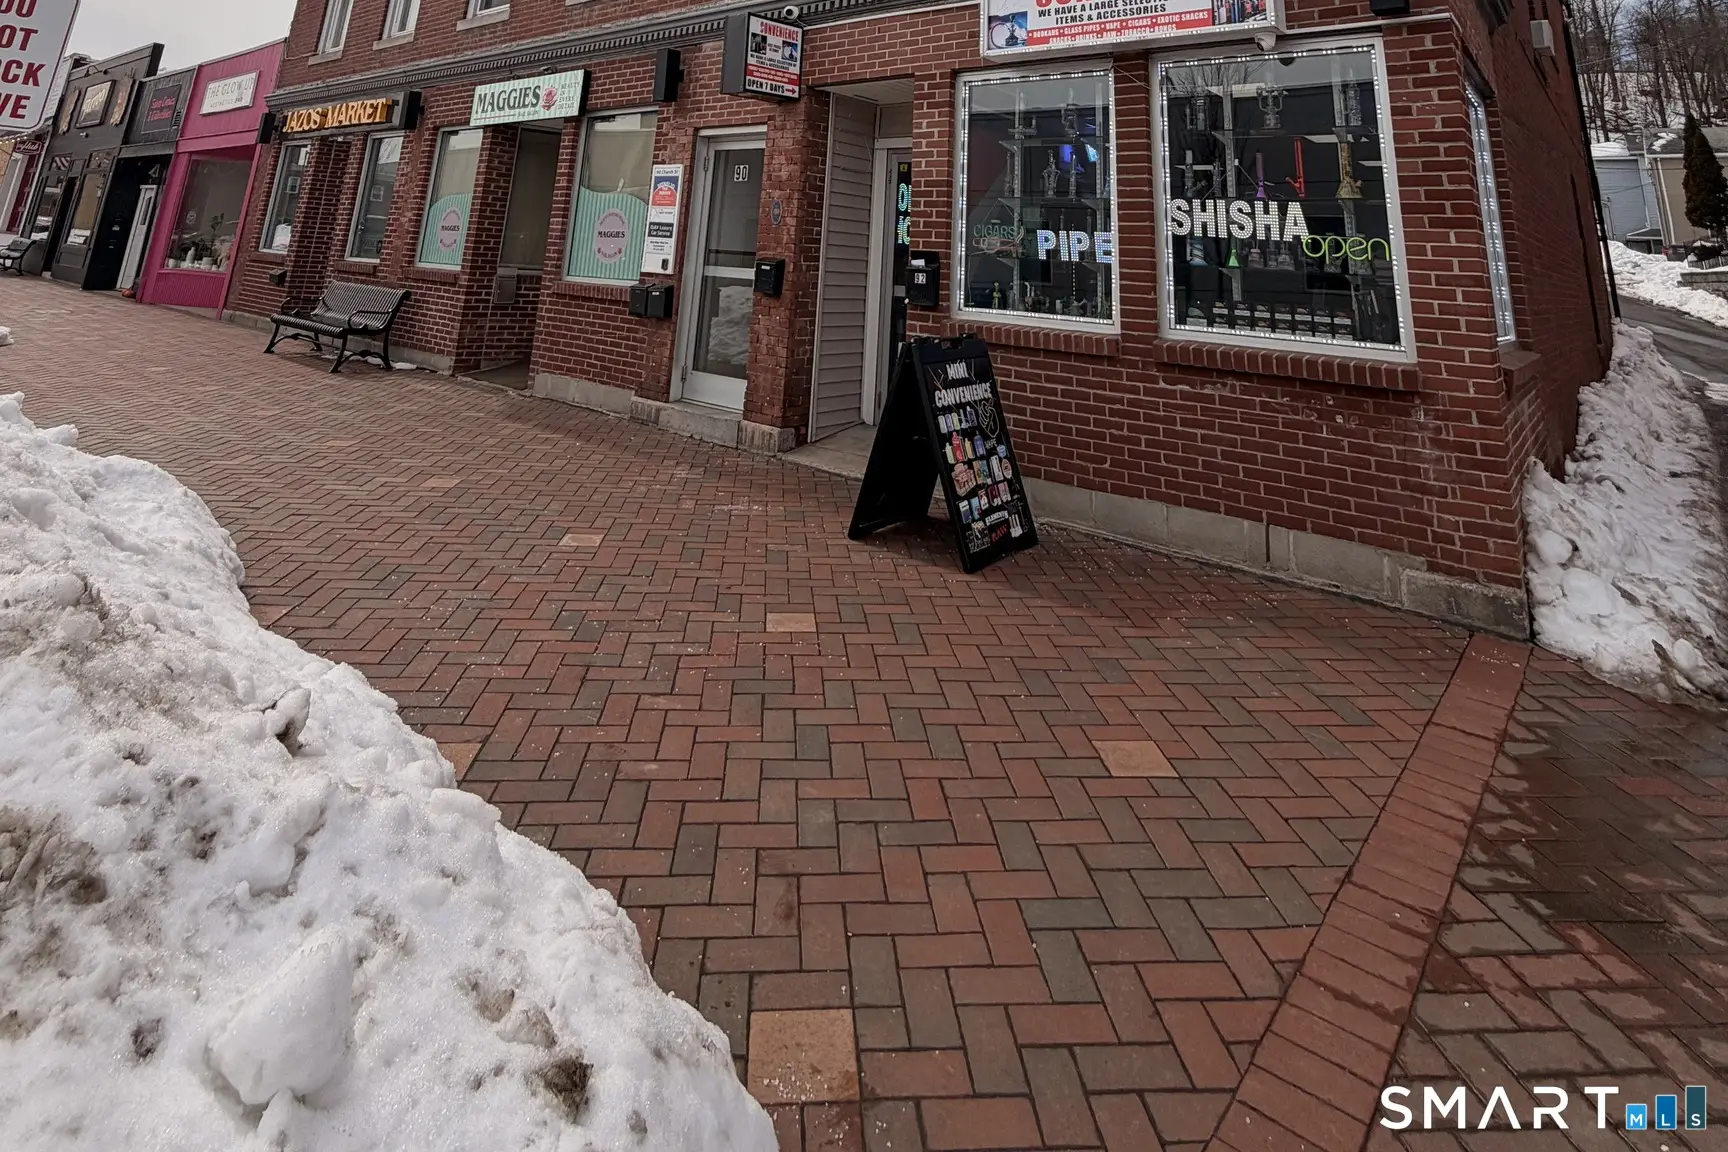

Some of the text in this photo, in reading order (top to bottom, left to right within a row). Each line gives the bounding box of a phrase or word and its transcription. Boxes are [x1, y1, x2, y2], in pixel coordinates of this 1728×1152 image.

[1038, 8, 1052, 18] WE
[1054, 4, 1078, 16] HAVE
[1080, 3, 1086, 12] A
[1089, 0, 1119, 11] LARGE
[1056, 4, 1166, 26] ITEMS & ACCESSORIES
[760, 21, 798, 42] CONVENIENCE
[1033, 11, 1208, 38] HOOKAHS GLASS PIPES VAPE CIGARS EXOTIC SNACKS
[1075, 32, 1098, 41] DRINKS
[1121, 27, 1150, 37] TOBACCO
[0, 24, 38, 51] OT
[0, 59, 46, 87] CK
[747, 78, 785, 94] OPEN 7 DAYS
[475, 85, 541, 114] MAGGIES
[283, 98, 386, 132] JAZOS MARKET
[736, 166, 747, 180] 90
[973, 225, 1016, 239] CIGARS
[1171, 198, 1310, 242] SHISHA
[1036, 230, 1113, 264] PIPE
[1303, 235, 1390, 264] open
[915, 273, 926, 283] 92
[946, 362, 969, 380] MINI
[935, 382, 992, 408] CONVENIENCE
